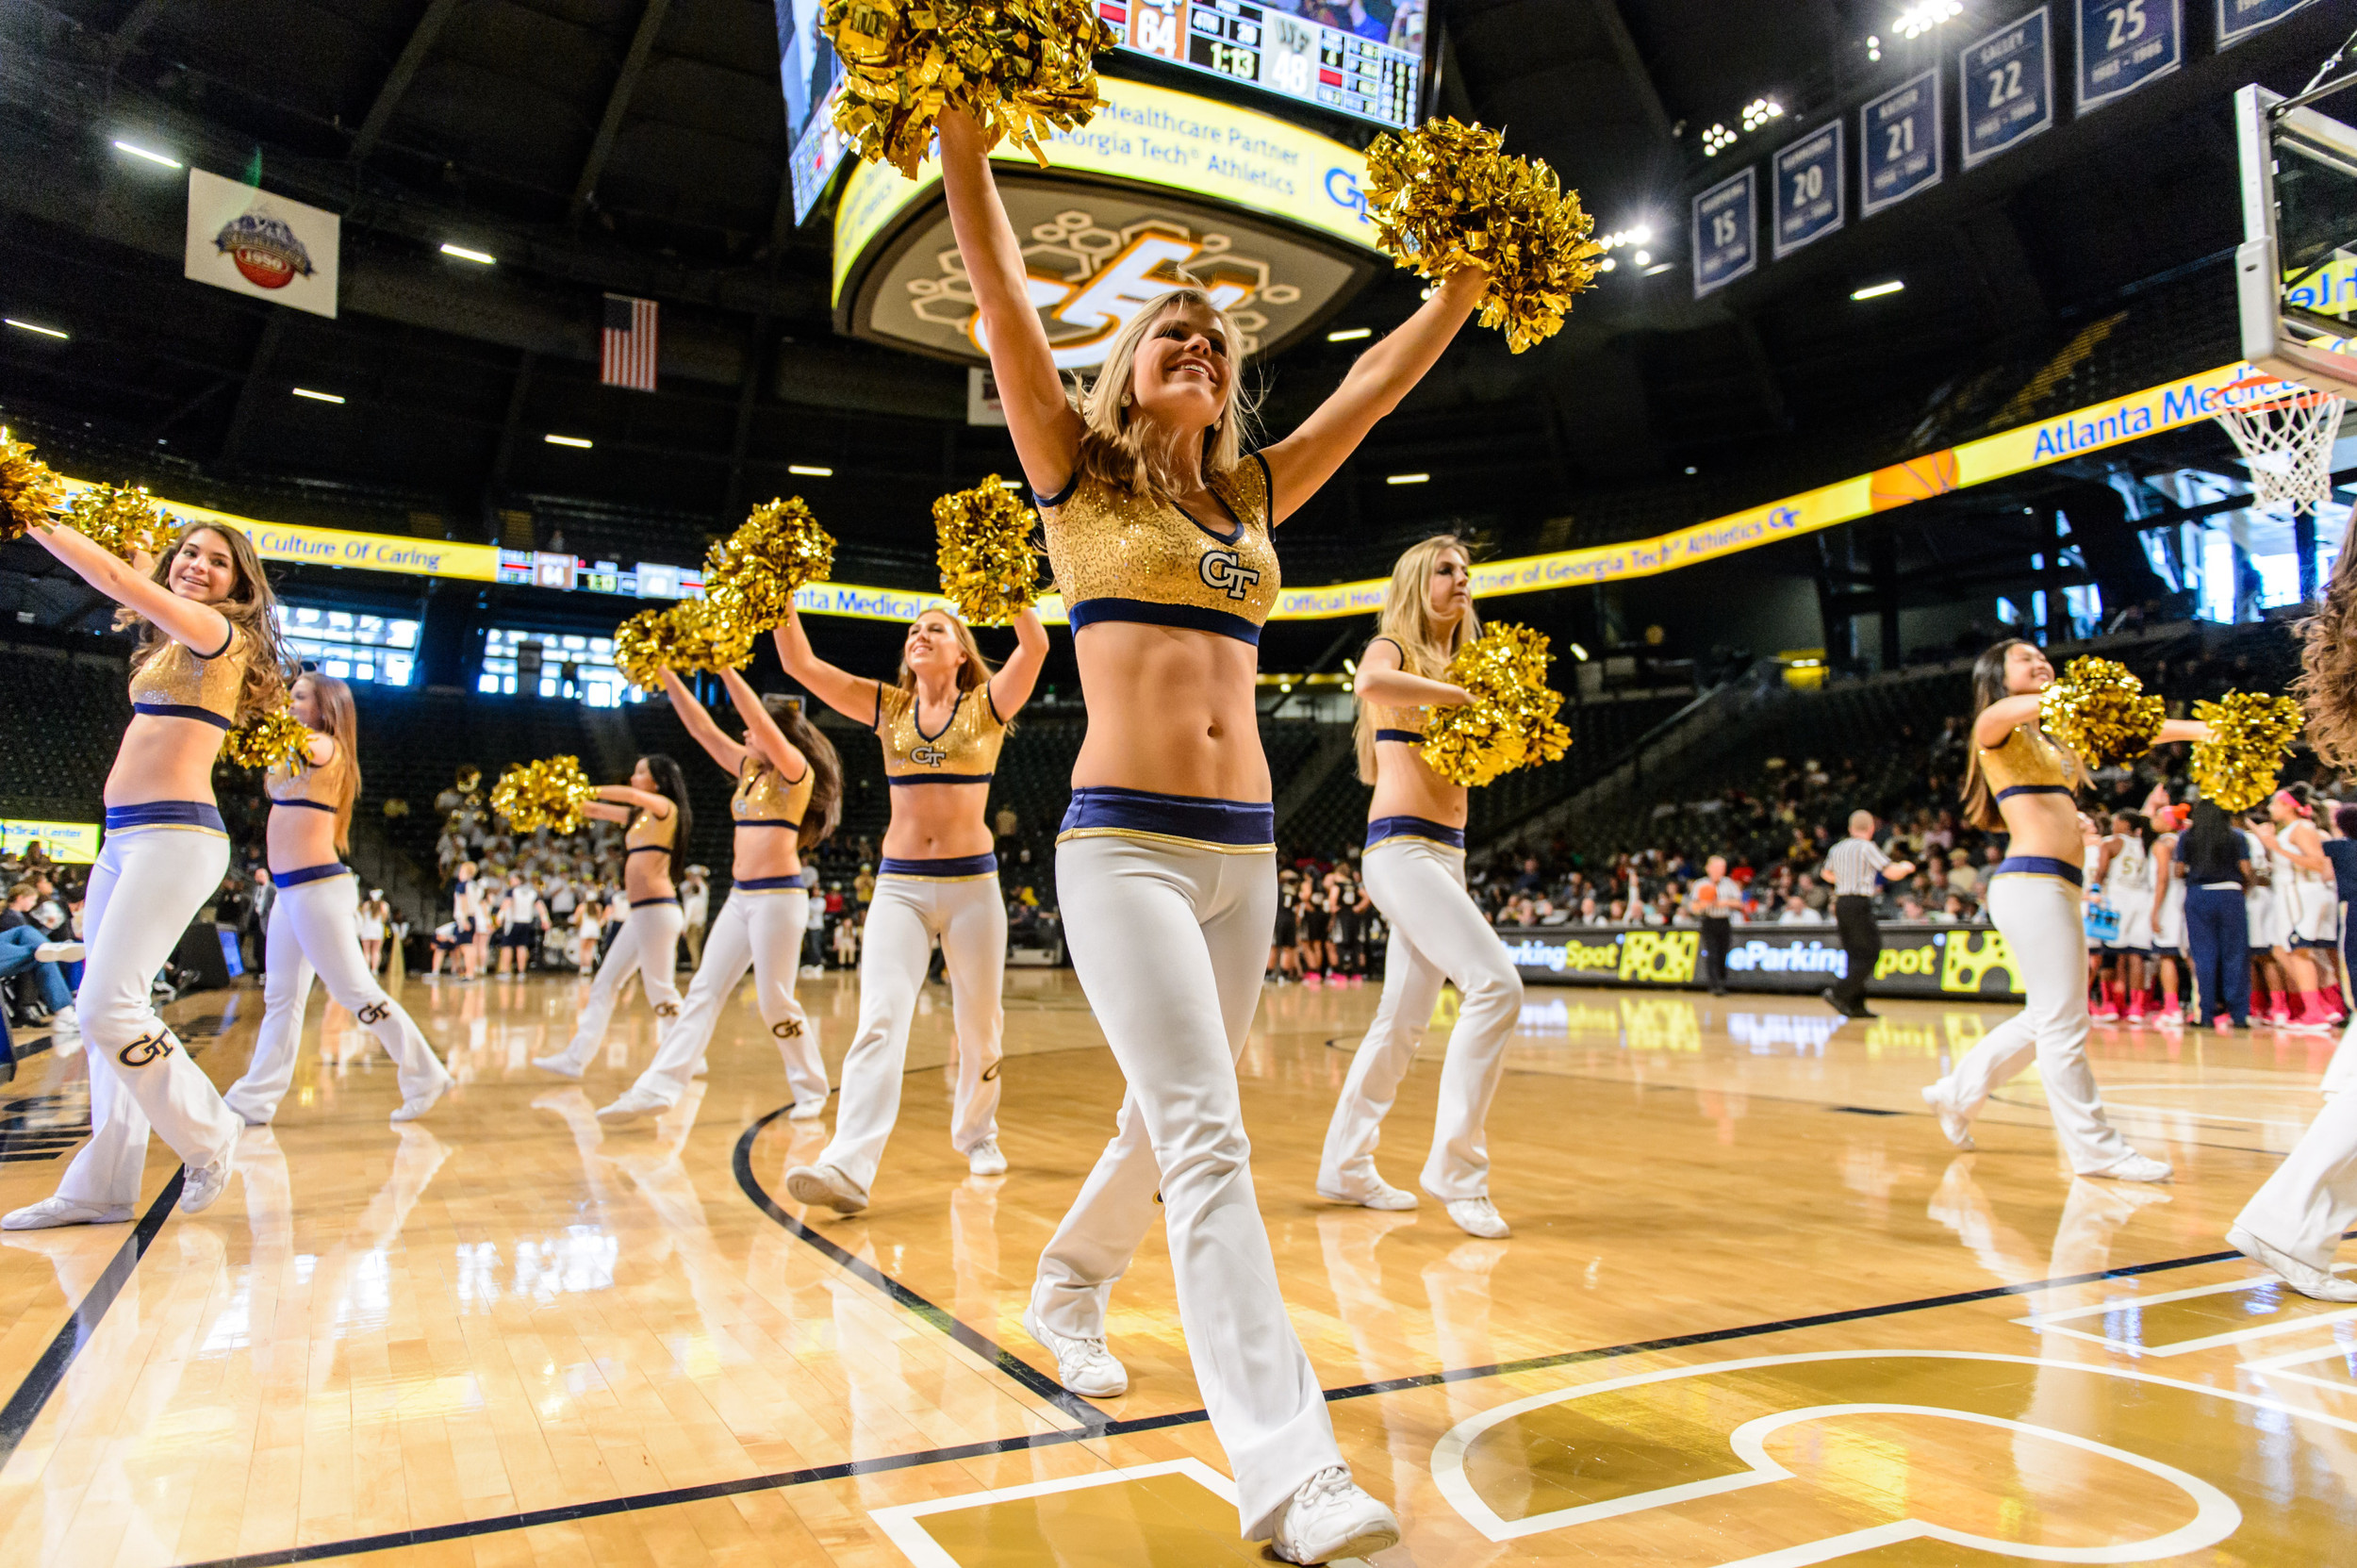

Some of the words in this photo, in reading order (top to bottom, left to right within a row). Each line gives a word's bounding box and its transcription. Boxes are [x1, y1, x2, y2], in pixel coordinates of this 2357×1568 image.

[1137, 8, 1177, 59] 64
[2106, 0, 2147, 52] 25
[1211, 42, 1255, 79] 1:13
[1273, 50, 1309, 94] 48
[1987, 59, 2023, 108] 22
[1101, 101, 1223, 143] Healthcare
[1228, 126, 1300, 167] Partner
[1887, 116, 1914, 162] 21
[1207, 155, 1296, 196] Athletics
[1793, 164, 1823, 208] 20
[1712, 208, 1737, 248] 15
[2033, 404, 2152, 461] Atlanta
[260, 532, 337, 556] Culture
[344, 541, 371, 559] Of
[376, 544, 441, 573] Caring
[1522, 563, 1541, 584] of
[1545, 552, 1624, 582] Georgia
[1686, 520, 1763, 556] Athletics
[1198, 550, 1260, 601] GT
[835, 590, 922, 619] Medical
[1283, 591, 1346, 613] Official
[910, 746, 947, 768] GT
[358, 999, 391, 1025] GT
[117, 1028, 175, 1068] GT
